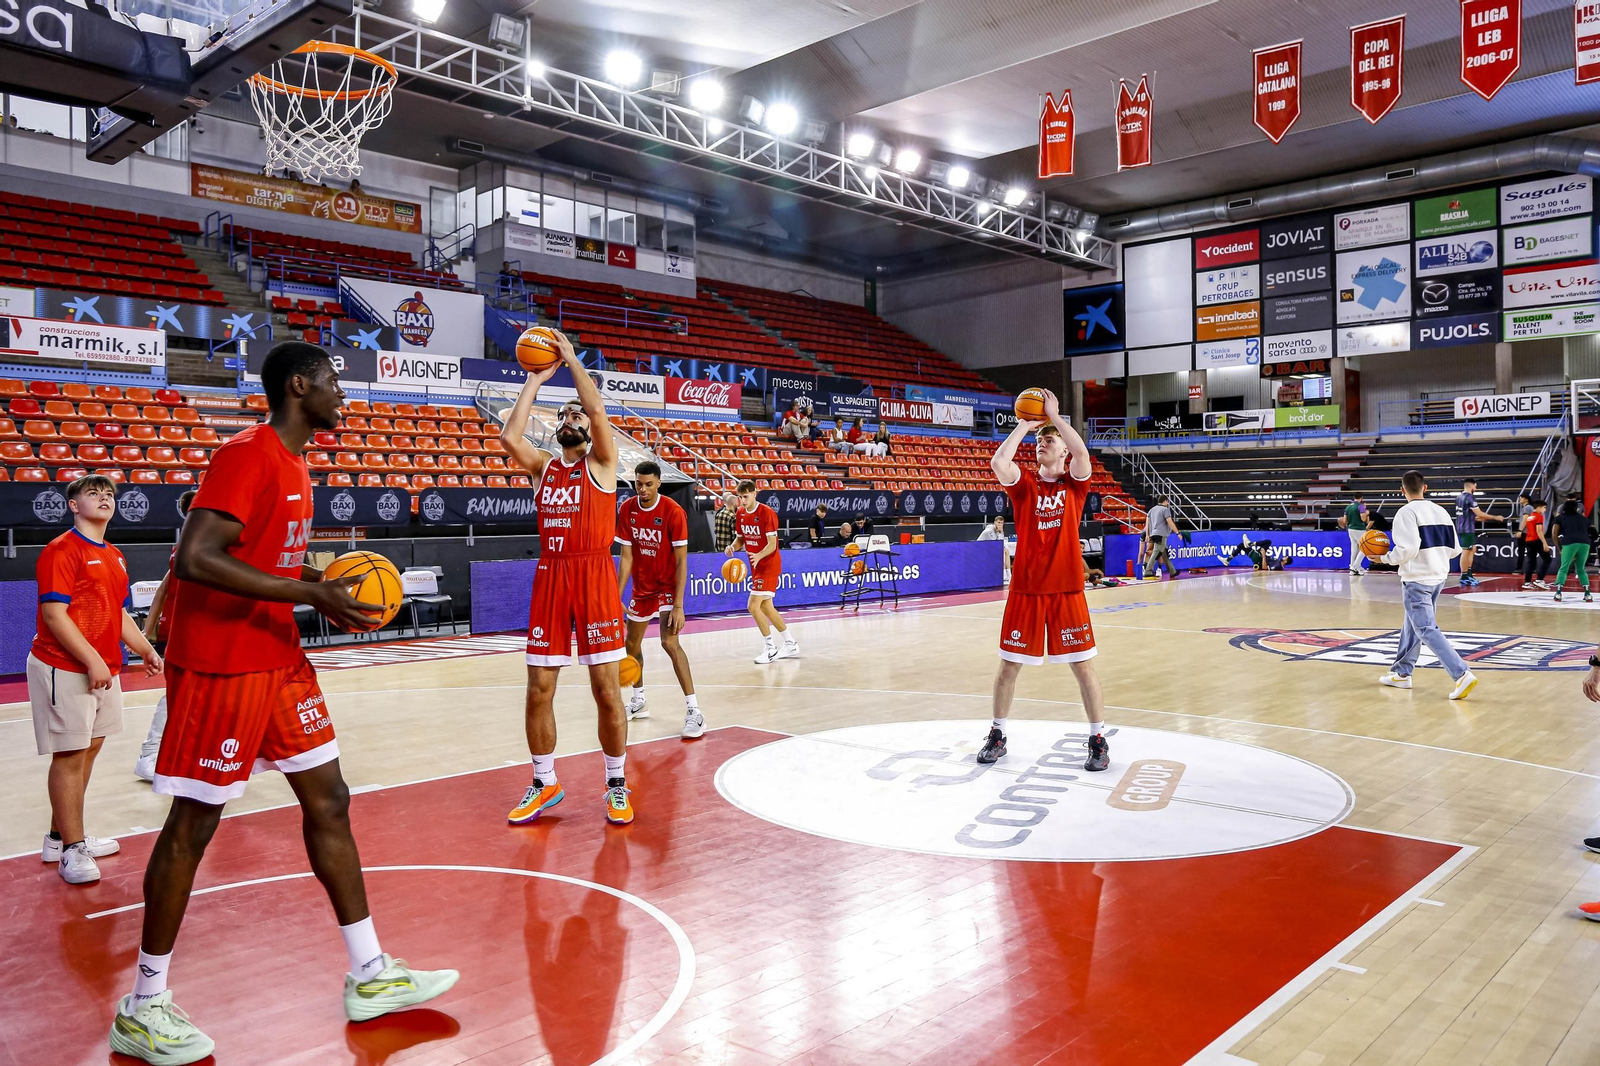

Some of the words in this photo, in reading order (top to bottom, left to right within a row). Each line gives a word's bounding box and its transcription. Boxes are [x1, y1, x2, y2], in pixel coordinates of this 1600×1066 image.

[1471, 6, 1509, 28] LLIGA
[1478, 29, 1502, 46] LEB
[1364, 39, 1389, 55] COPA
[1358, 60, 1376, 73] DEL
[1378, 54, 1394, 69] REI
[1466, 48, 1514, 68] 2006-07
[1264, 61, 1289, 77] LLIGA
[1258, 76, 1296, 95] CATALANA
[1361, 78, 1391, 93] 1995-96
[1137, 93, 1146, 102] 10
[1268, 100, 1286, 111] 1999
[1125, 121, 1142, 130] TDK
[1505, 182, 1587, 201] Sagalés
[246, 195, 286, 209] DIGITAL
[1521, 204, 1534, 212] 902
[363, 204, 390, 218] TDT
[1440, 210, 1469, 221] BRASILIA
[1510, 205, 1581, 220] www.sagales.com
[545, 233, 574, 243] JUANOLA
[1266, 227, 1324, 248] JOVIAT
[1540, 233, 1579, 244] BAGESNET
[1212, 242, 1253, 256] Occident
[1421, 245, 1447, 258] ALL
[1450, 242, 1467, 254] IN
[1447, 252, 1468, 263] S4B
[1266, 266, 1327, 286] sensus
[1378, 267, 1406, 276] DELIVERY
[1216, 282, 1239, 291] GRUP
[1202, 289, 1254, 302] PETROBAGES
[397, 311, 433, 329] BAXI
[1215, 309, 1258, 322] innaltech
[1513, 314, 1552, 323] BUSQUEM
[39, 325, 101, 337] construccions
[403, 328, 428, 337] MANRESA
[1216, 324, 1258, 333] www.innaltech.com
[39, 333, 131, 356] marmik,
[137, 341, 163, 356] s.l.
[1268, 338, 1311, 349] movento
[1225, 352, 1240, 361] Josep
[1246, 338, 1259, 364] CSJ
[1268, 348, 1296, 357] sarsa
[87, 352, 120, 361] 659592880
[124, 355, 156, 364] 938747883
[399, 359, 459, 380] AIGNEP
[1277, 361, 1325, 375] BAR
[607, 379, 659, 395] SCANIA
[772, 377, 813, 391] mecexis
[832, 396, 845, 405] CAL
[845, 397, 877, 407] SPAGUETTI
[1480, 396, 1542, 414] AIGNEP
[1289, 414, 1307, 423] brot
[1308, 413, 1324, 422] d'or
[542, 485, 580, 505] BAXI
[35, 501, 65, 510] BAXI
[120, 500, 147, 509] BAXI
[332, 502, 355, 510] BAXI
[378, 502, 398, 510] BAXI
[424, 502, 443, 510] BAXI
[631, 527, 662, 543] BAXI
[741, 525, 761, 535] BAXI
[1178, 543, 1218, 559] información:
[588, 629, 602, 638] ETL
[589, 635, 613, 645] GLOBAL
[1062, 633, 1075, 641] ETL
[1003, 639, 1027, 648] unilabor
[1063, 639, 1085, 647] GLOBAL
[299, 708, 322, 724] ETL
[199, 757, 243, 772] unilabor
[1121, 763, 1178, 804] GROUP
